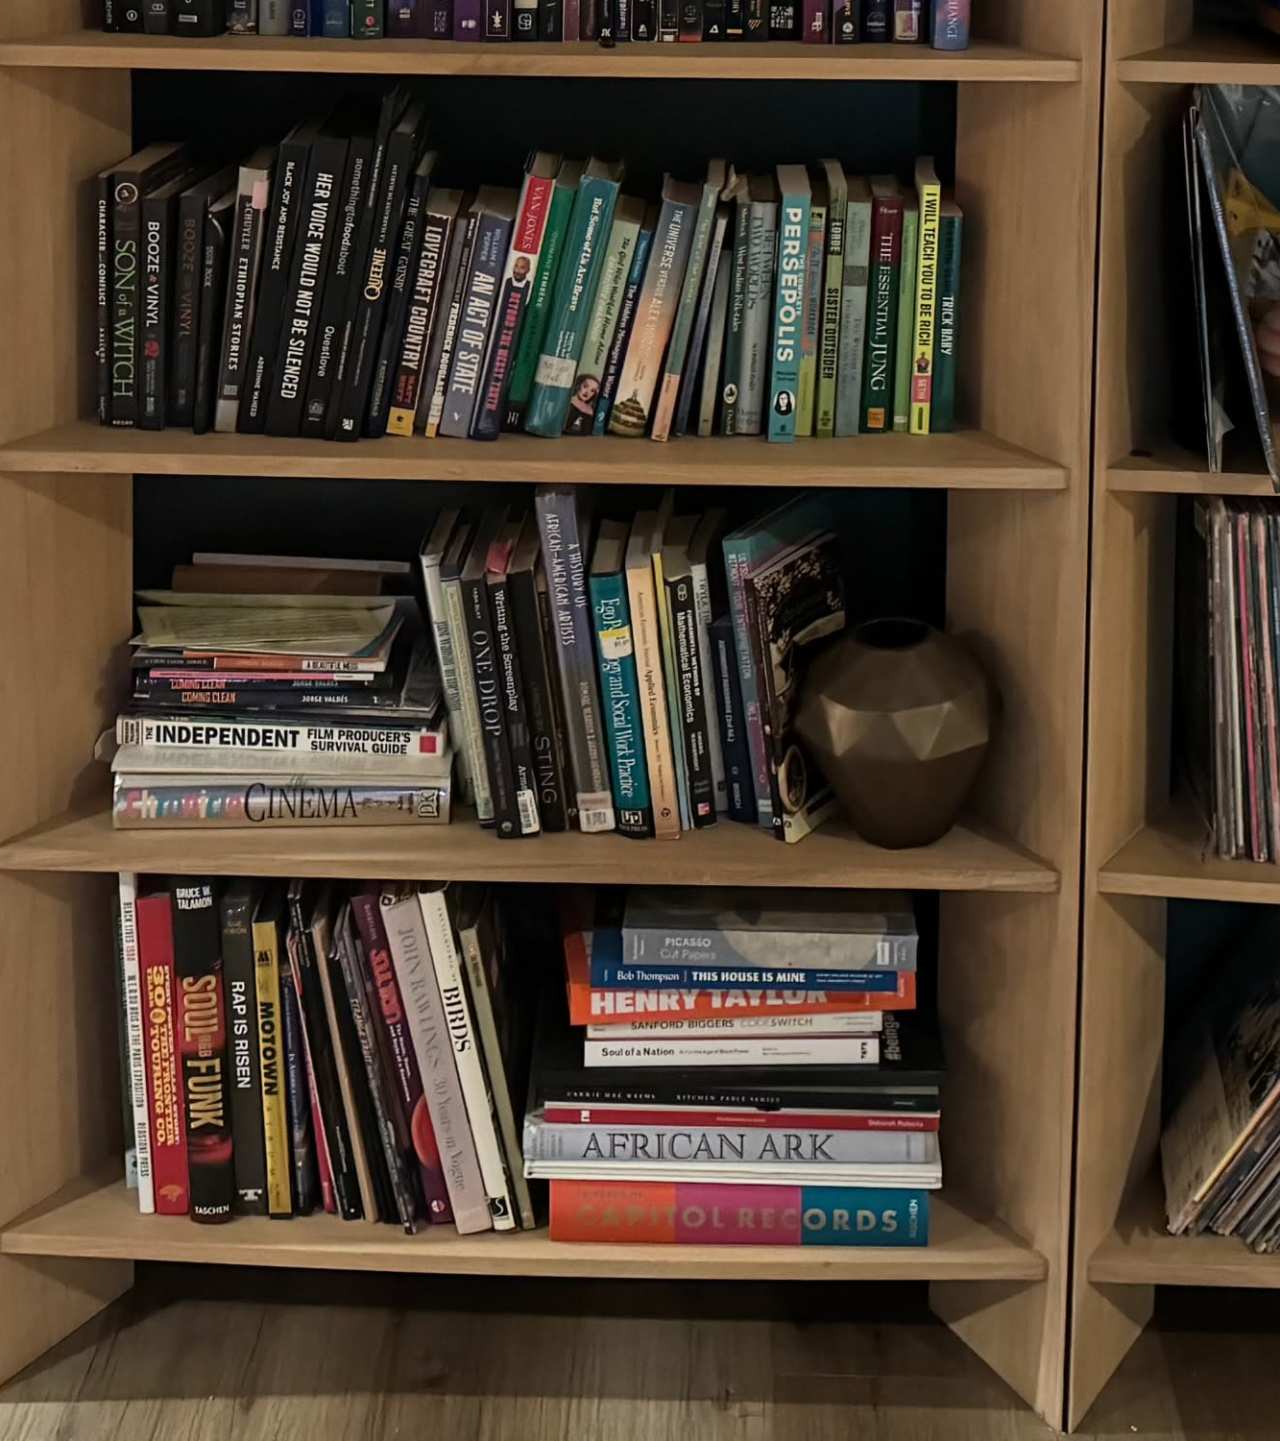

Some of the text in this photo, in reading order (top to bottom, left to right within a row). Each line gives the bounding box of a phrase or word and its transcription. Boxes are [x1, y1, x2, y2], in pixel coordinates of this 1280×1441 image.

[520, 184, 545, 250] VAN JONES
[923, 227, 936, 261] TEACH
[924, 198, 938, 226] WILL
[145, 221, 161, 328] BOOZE VINYL
[280, 172, 334, 400] HER VOICE WOULD NOT BE SILENCED
[401, 225, 443, 371] LOVECRAFT COUNTRY
[776, 207, 803, 363] PERSEPOLIS
[920, 287, 935, 301] TO
[921, 263, 936, 286] YOU
[112, 239, 136, 398] SON of a WITCH
[451, 271, 496, 396] AN ACT OF STATE
[822, 287, 839, 380] SISTER OUTSIDER
[868, 231, 894, 391] THE ESSENTIAL JUNG
[918, 319, 933, 346] RICH
[920, 303, 933, 318] BE
[471, 629, 502, 736] ONE DROP
[155, 725, 300, 748] INDEPENDENT
[306, 728, 412, 744] FILM PRODUCER'S
[310, 741, 408, 756] SURVIVAL GUIDE
[534, 733, 558, 804] STING
[244, 782, 358, 823] CINEMA
[181, 973, 220, 1043] SOUL
[591, 989, 702, 1016] HENRY
[616, 970, 681, 985] Bob Thompson
[691, 971, 807, 984] THIS HOUSE IS MINE
[231, 980, 252, 1088] RAP IS RISEN
[259, 1001, 278, 1096] MOTOWN
[442, 985, 471, 1054] BIRDS
[185, 1057, 224, 1130] FUNK
[581, 1131, 837, 1162] AFRICAN ARK
